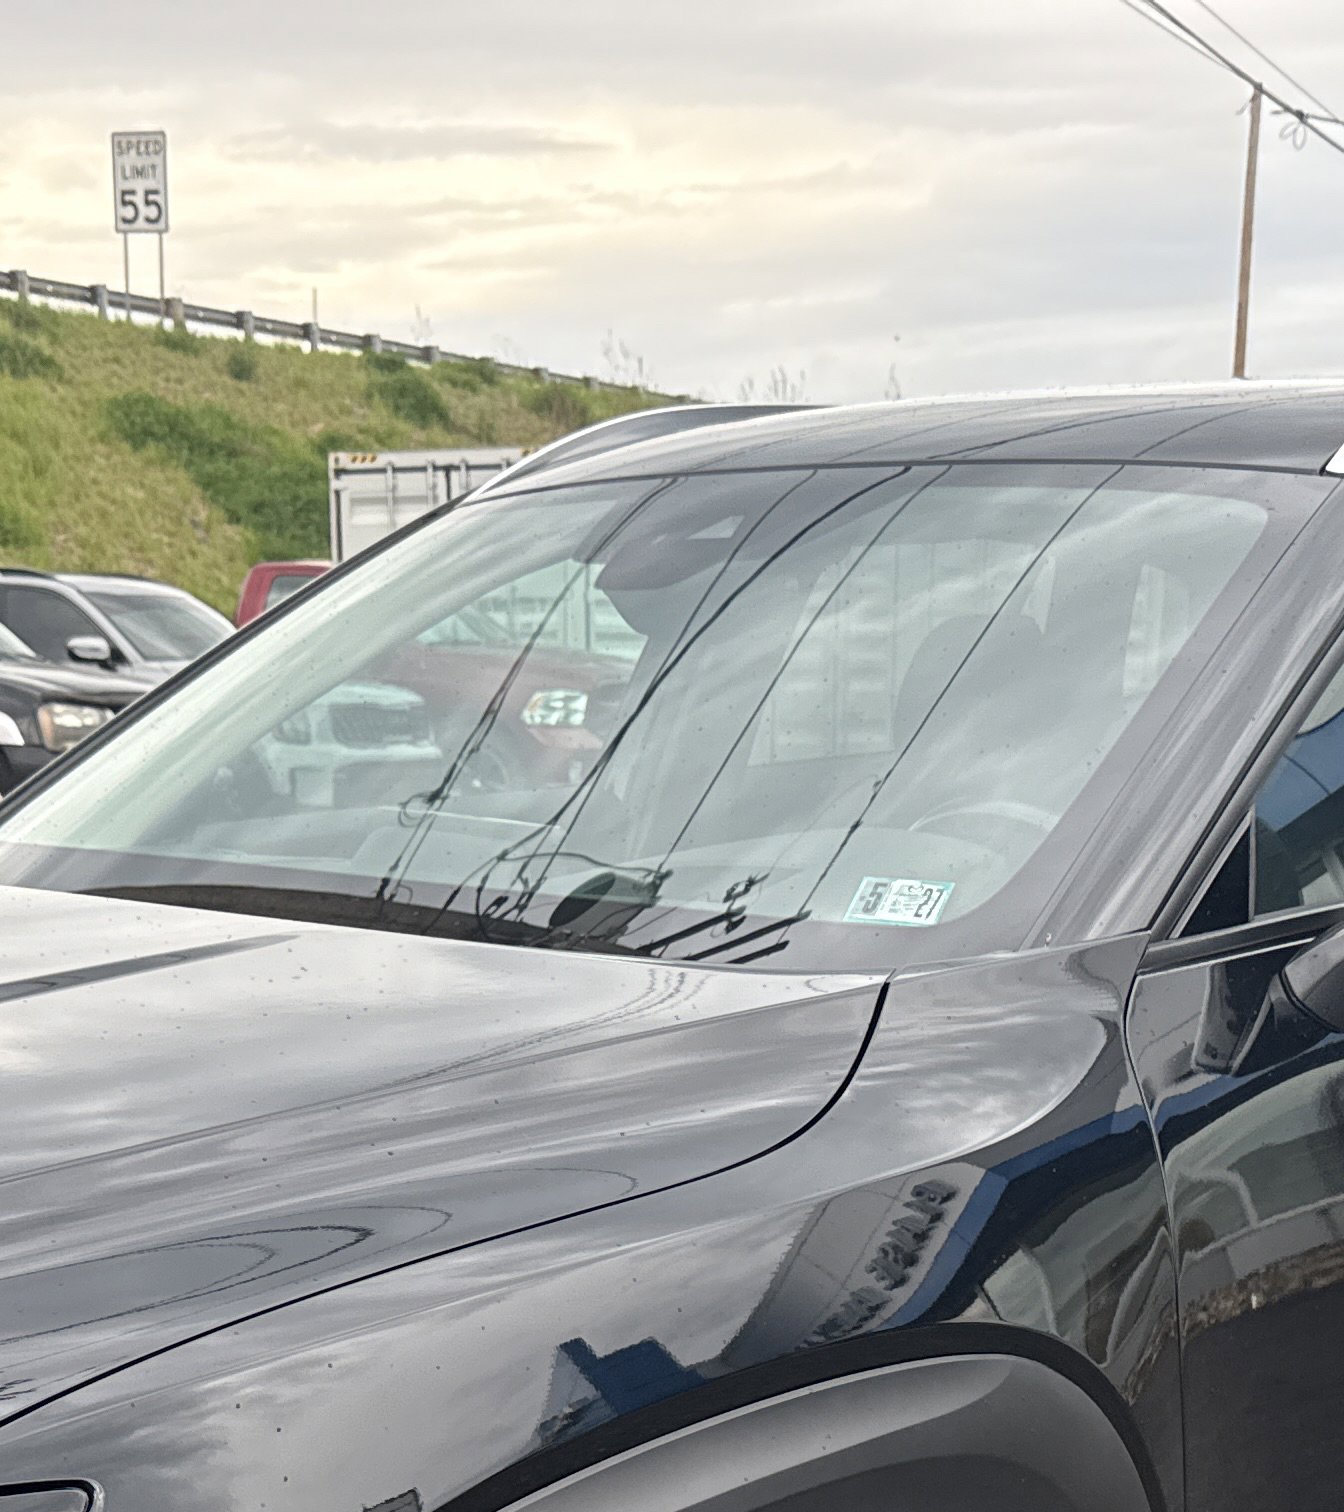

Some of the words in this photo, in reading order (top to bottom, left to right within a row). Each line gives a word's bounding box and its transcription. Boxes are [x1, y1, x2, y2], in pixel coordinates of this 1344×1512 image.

[116, 139, 164, 156] SPEED
[120, 163, 158, 180] LIMIT
[120, 189, 162, 225] 55
[913, 888, 945, 920] 27
